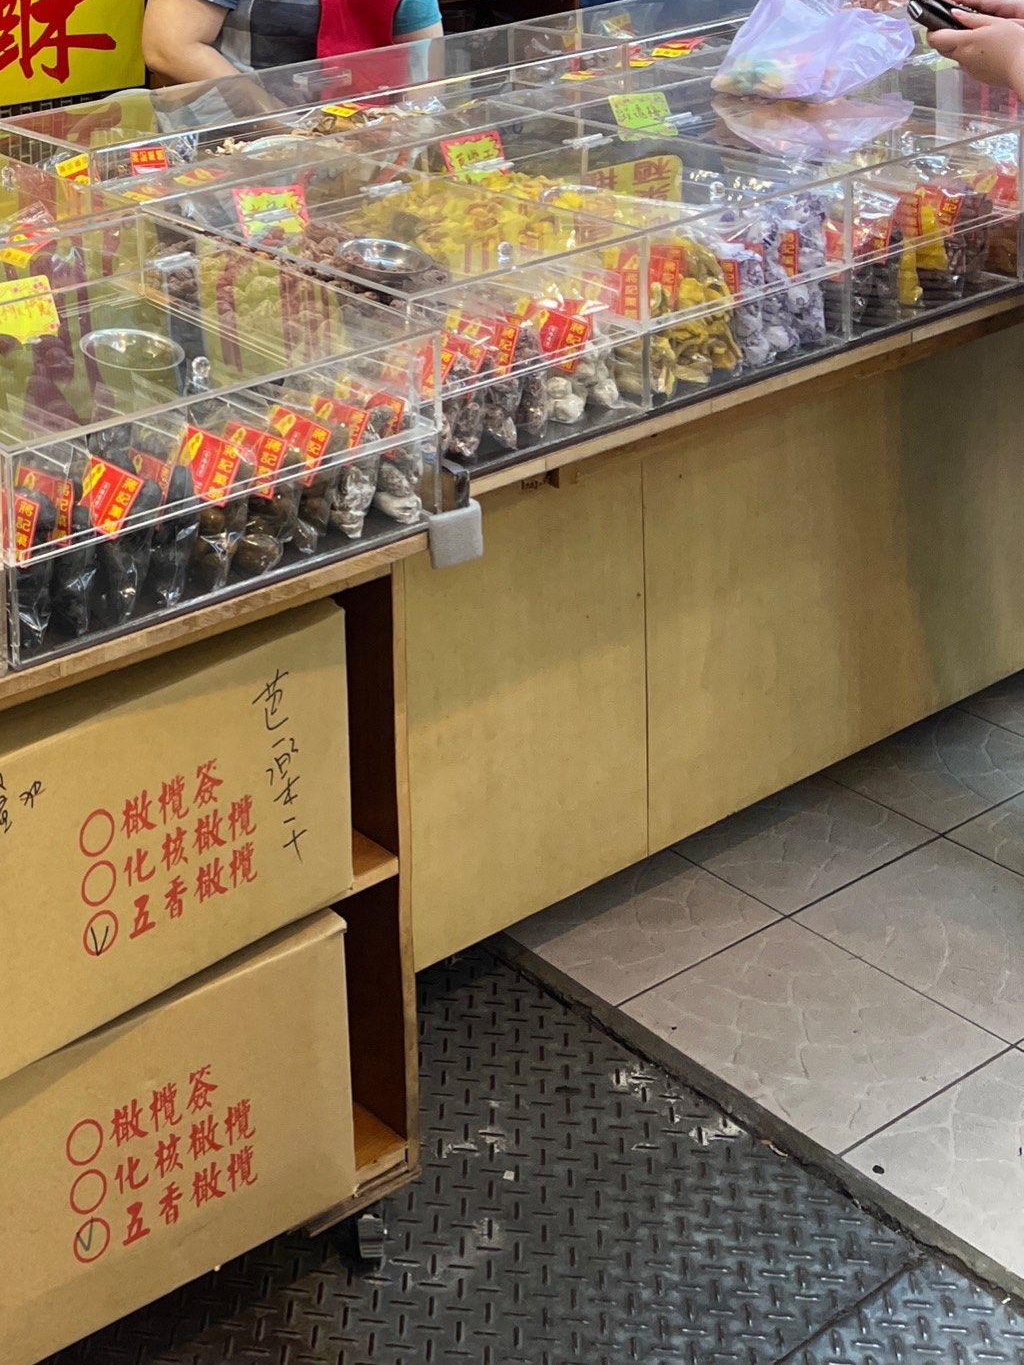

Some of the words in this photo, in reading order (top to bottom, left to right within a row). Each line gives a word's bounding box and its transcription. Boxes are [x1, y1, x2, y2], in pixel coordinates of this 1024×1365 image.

[123, 795, 257, 887] 化核橄欖
[128, 842, 258, 939] 五香橄欖
[114, 1099, 256, 1195] 化核橄欖
[122, 1145, 258, 1247] 五香橄欖
